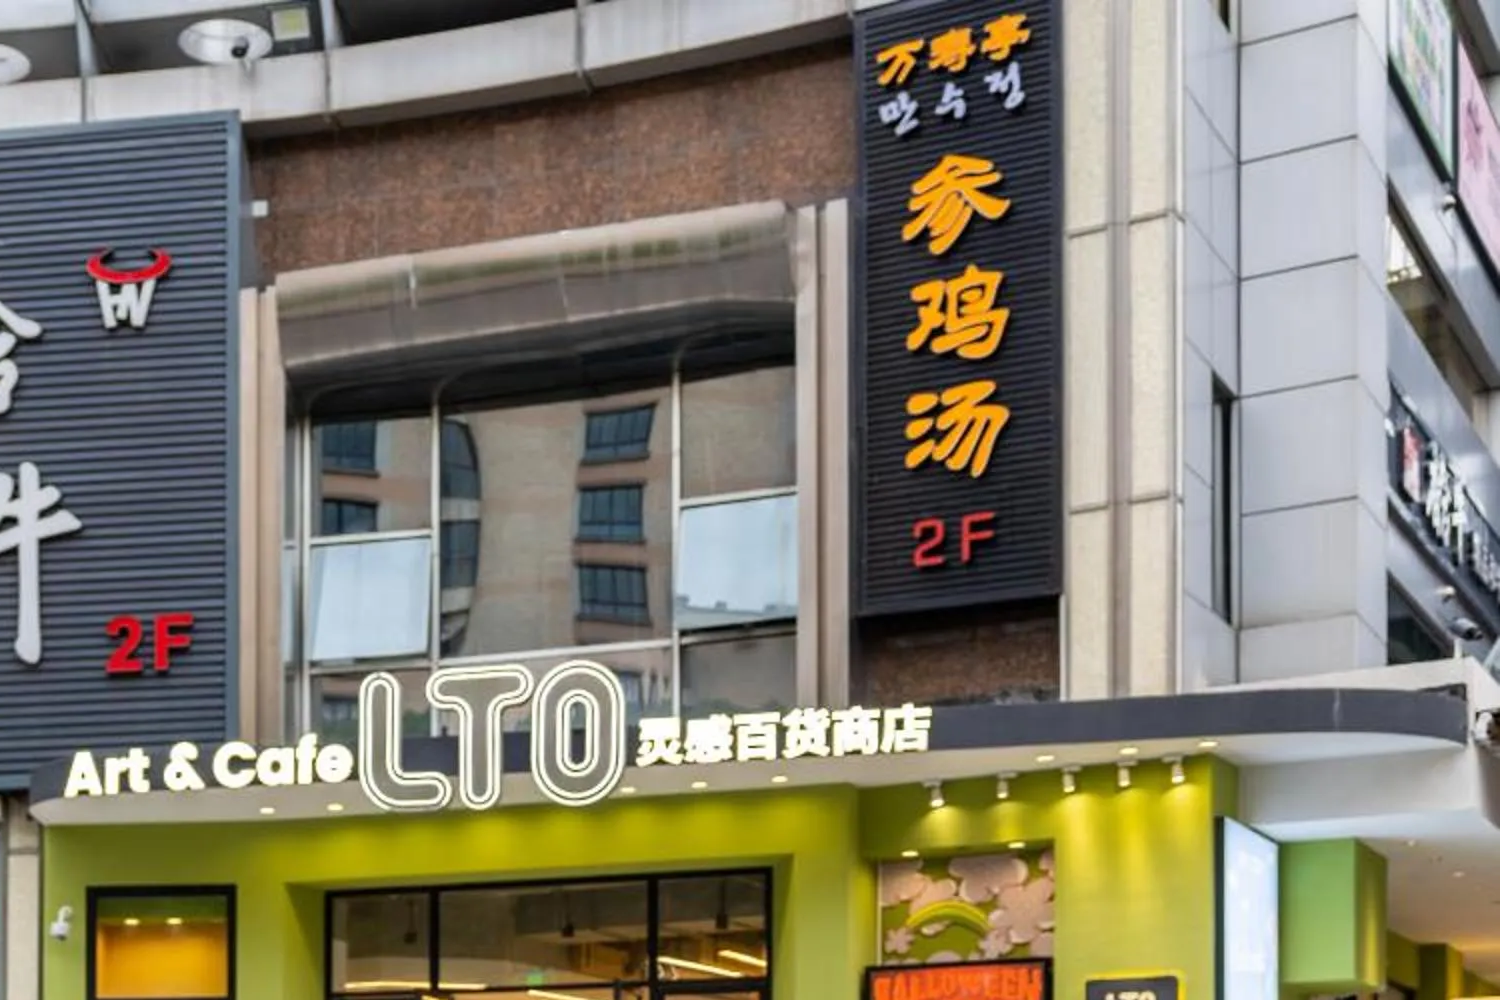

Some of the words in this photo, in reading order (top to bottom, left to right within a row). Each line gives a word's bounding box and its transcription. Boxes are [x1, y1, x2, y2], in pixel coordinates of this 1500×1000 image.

[902, 154, 1010, 478] 参鸡汤
[912, 511, 995, 567] 2F
[105, 612, 194, 675] 2F
[64, 748, 150, 798] Art
[164, 741, 205, 792] &
[213, 733, 354, 789] Cafe
[359, 660, 625, 811] LTO
[636, 703, 932, 767] 灵感百货商店
